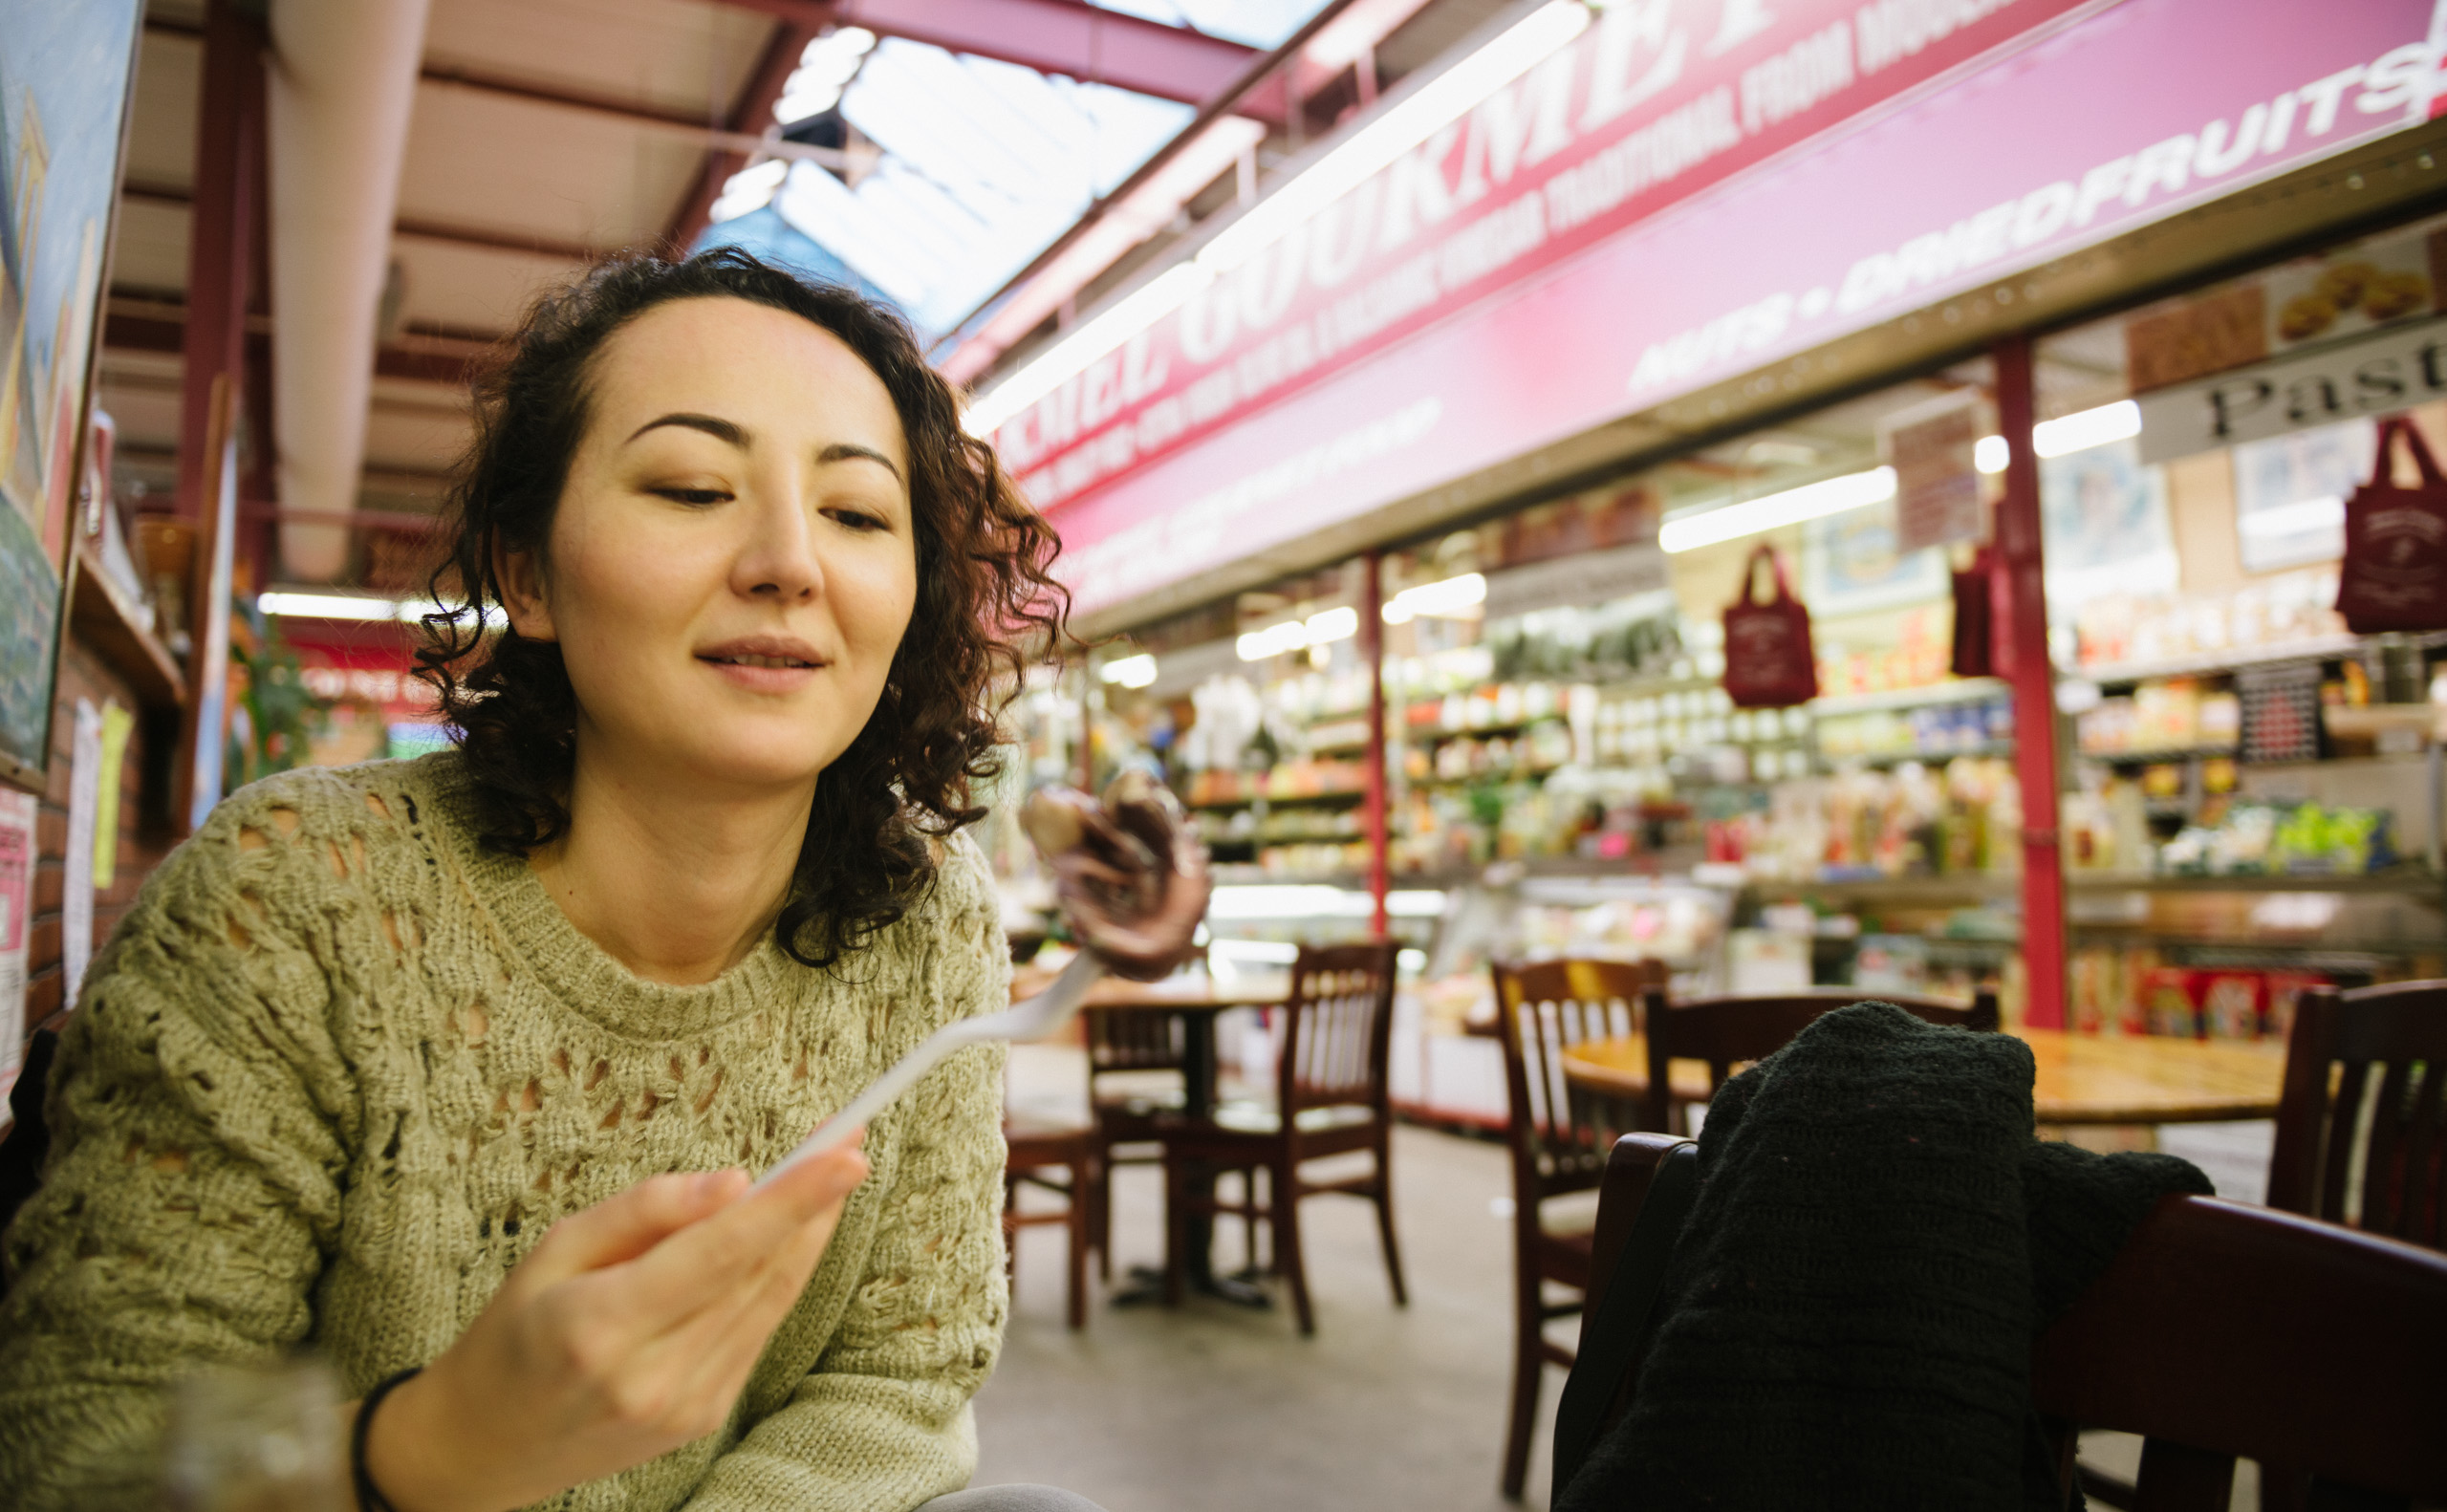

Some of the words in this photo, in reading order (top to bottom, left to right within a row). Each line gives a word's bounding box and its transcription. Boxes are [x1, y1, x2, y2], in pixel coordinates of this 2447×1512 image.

[1177, 0, 1780, 365] GOURME
[1628, 291, 1794, 394] NUTS
[2207, 337, 2447, 436] Past
